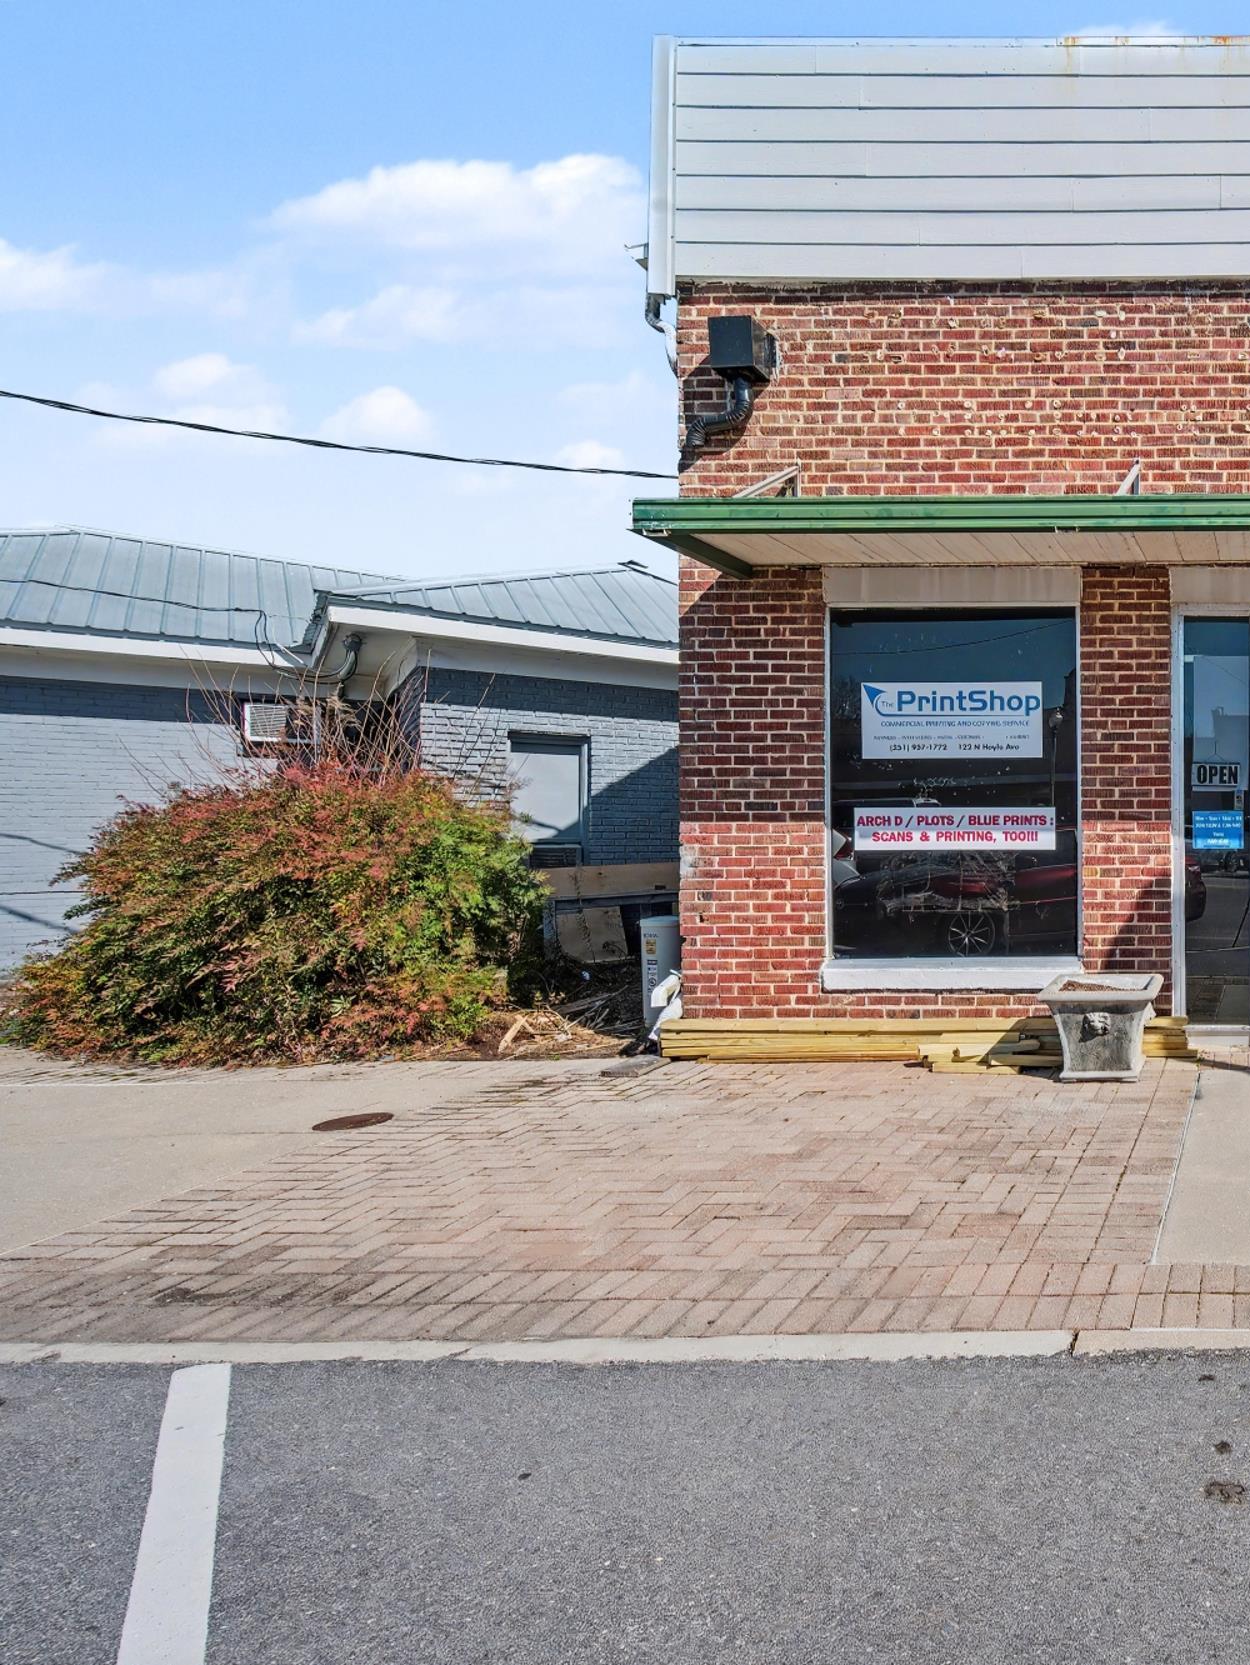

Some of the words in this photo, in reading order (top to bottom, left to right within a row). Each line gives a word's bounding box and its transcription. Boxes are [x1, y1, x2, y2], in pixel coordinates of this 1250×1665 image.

[897, 690, 1041, 716] PrintShop
[959, 743, 972, 751] 122
[974, 743, 981, 751] N
[1197, 765, 1238, 785] OPEN
[857, 815, 892, 827] ARCH
[894, 815, 903, 827] D
[916, 815, 955, 826] PLOTS
[968, 815, 1000, 826] BLUE
[1003, 815, 1048, 826] PRINTS
[872, 831, 914, 842] SCANS
[919, 831, 930, 842] &
[936, 831, 997, 843] PRINTING,
